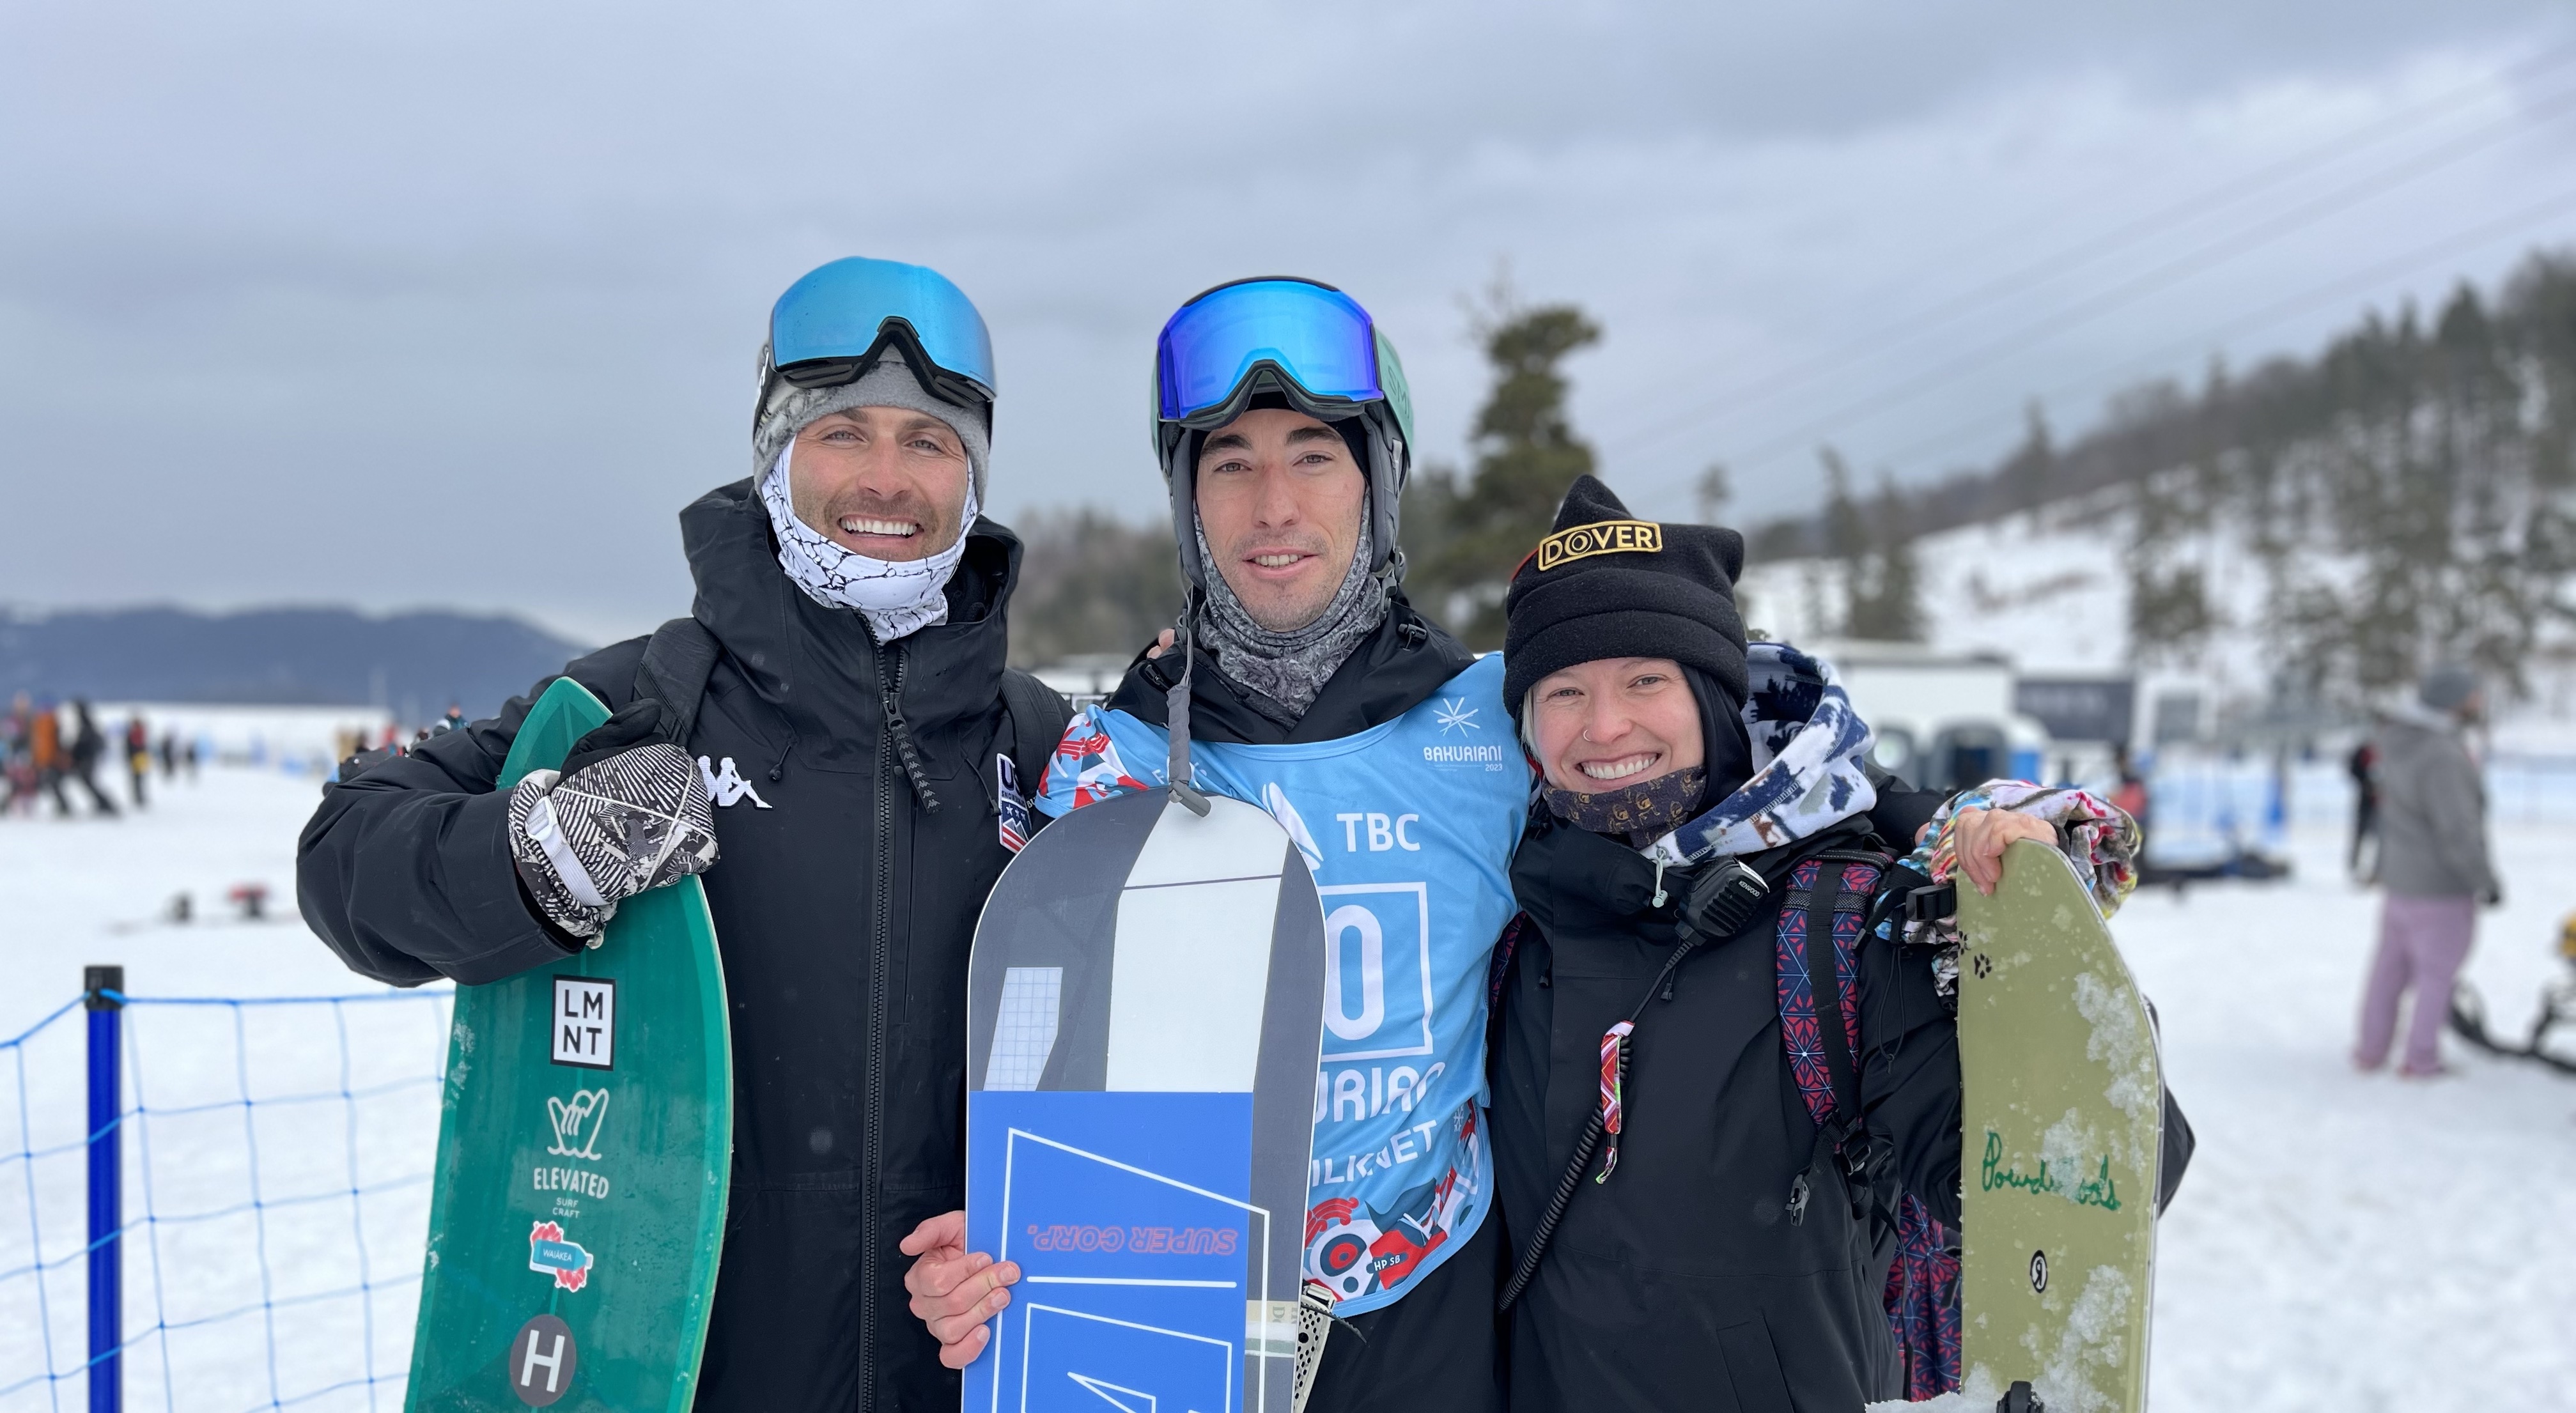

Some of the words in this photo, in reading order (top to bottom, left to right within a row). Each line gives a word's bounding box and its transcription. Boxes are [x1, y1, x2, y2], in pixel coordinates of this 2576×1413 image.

[1545, 526, 1653, 564] DOVER
[1424, 746, 1502, 762] BAKURIANI
[1336, 813, 1421, 852] TBC
[1738, 880, 1760, 897] KENWOOD
[564, 989, 603, 1020] LM
[563, 1025, 603, 1056] NT
[534, 1167, 609, 1199] ELEVATED
[552, 1207, 580, 1219] CRAFT
[556, 1197, 578, 1208] SURF
[1027, 1224, 1126, 1253] CORP.
[1128, 1226, 1239, 1256] SUPER
[1374, 1260, 1388, 1271] HP
[1390, 1255, 1401, 1266] SB
[520, 1329, 565, 1393] H
